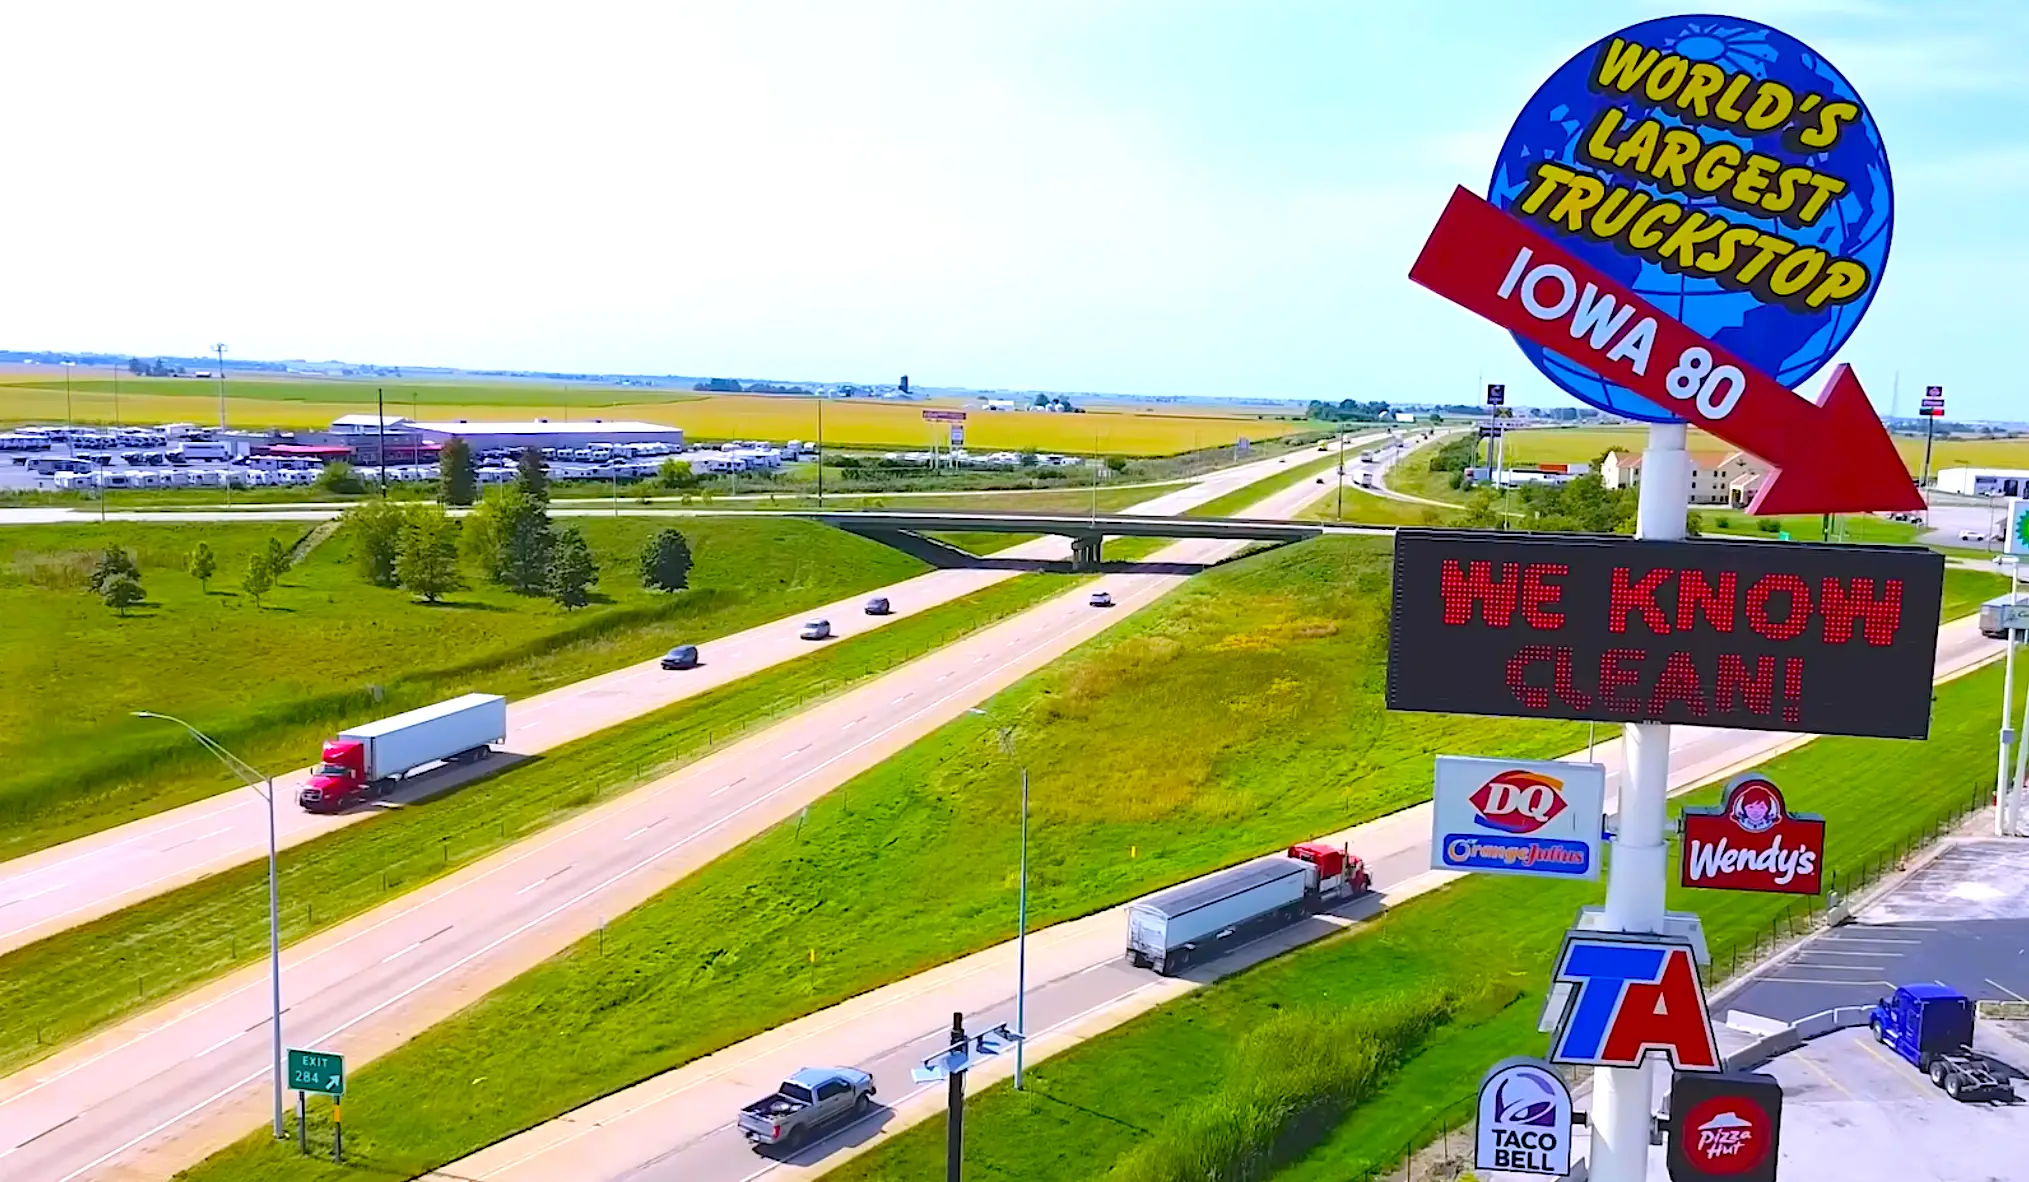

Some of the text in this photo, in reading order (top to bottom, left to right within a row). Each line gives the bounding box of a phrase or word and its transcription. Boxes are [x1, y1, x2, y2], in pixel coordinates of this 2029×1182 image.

[1597, 36, 1860, 150] WORLD'S
[1588, 107, 1847, 227] LARGEST
[1519, 162, 1869, 310] TRUCKSTOP
[1497, 246, 1747, 421] IOWA 80
[1440, 558, 1903, 647] WE KNOW
[1505, 644, 1804, 724] CLEAN!
[1483, 782, 1555, 822] DQ
[1689, 834, 1817, 885] Wendy's
[1559, 943, 1717, 1069] TA
[295, 1070, 319, 1083] 284
[302, 1055, 328, 1068] EXIT
[1491, 1128, 1557, 1152] TACO
[1494, 1149, 1555, 1172] BELL
[1697, 1128, 1752, 1150] Pizza
[1706, 1143, 1741, 1160] Hut
